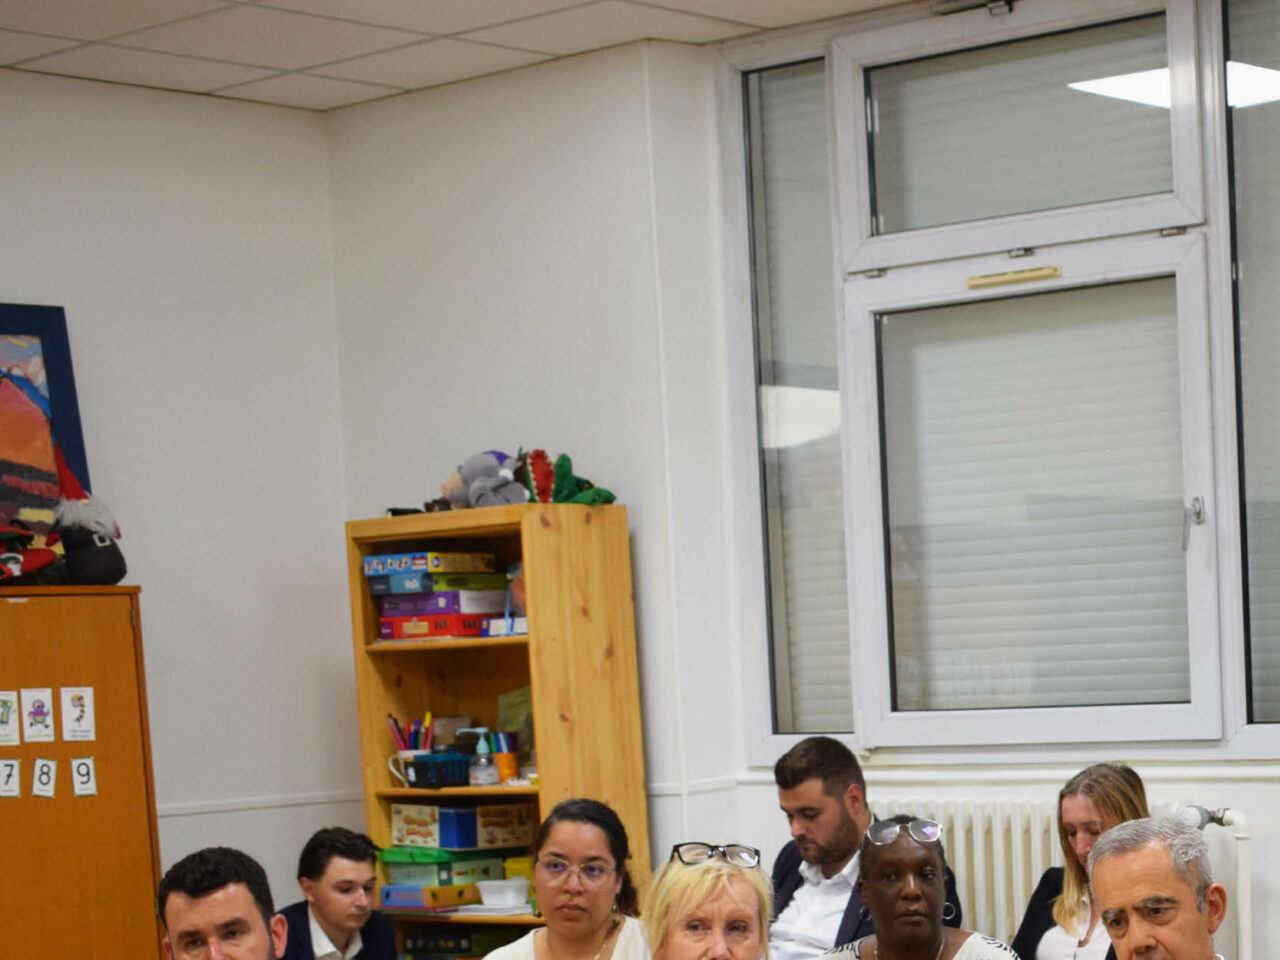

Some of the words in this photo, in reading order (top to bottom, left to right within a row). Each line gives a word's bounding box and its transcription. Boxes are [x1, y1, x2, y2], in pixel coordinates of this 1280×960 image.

[4, 764, 15, 786] 7
[38, 764, 51, 786] 8
[77, 762, 91, 785] 9
